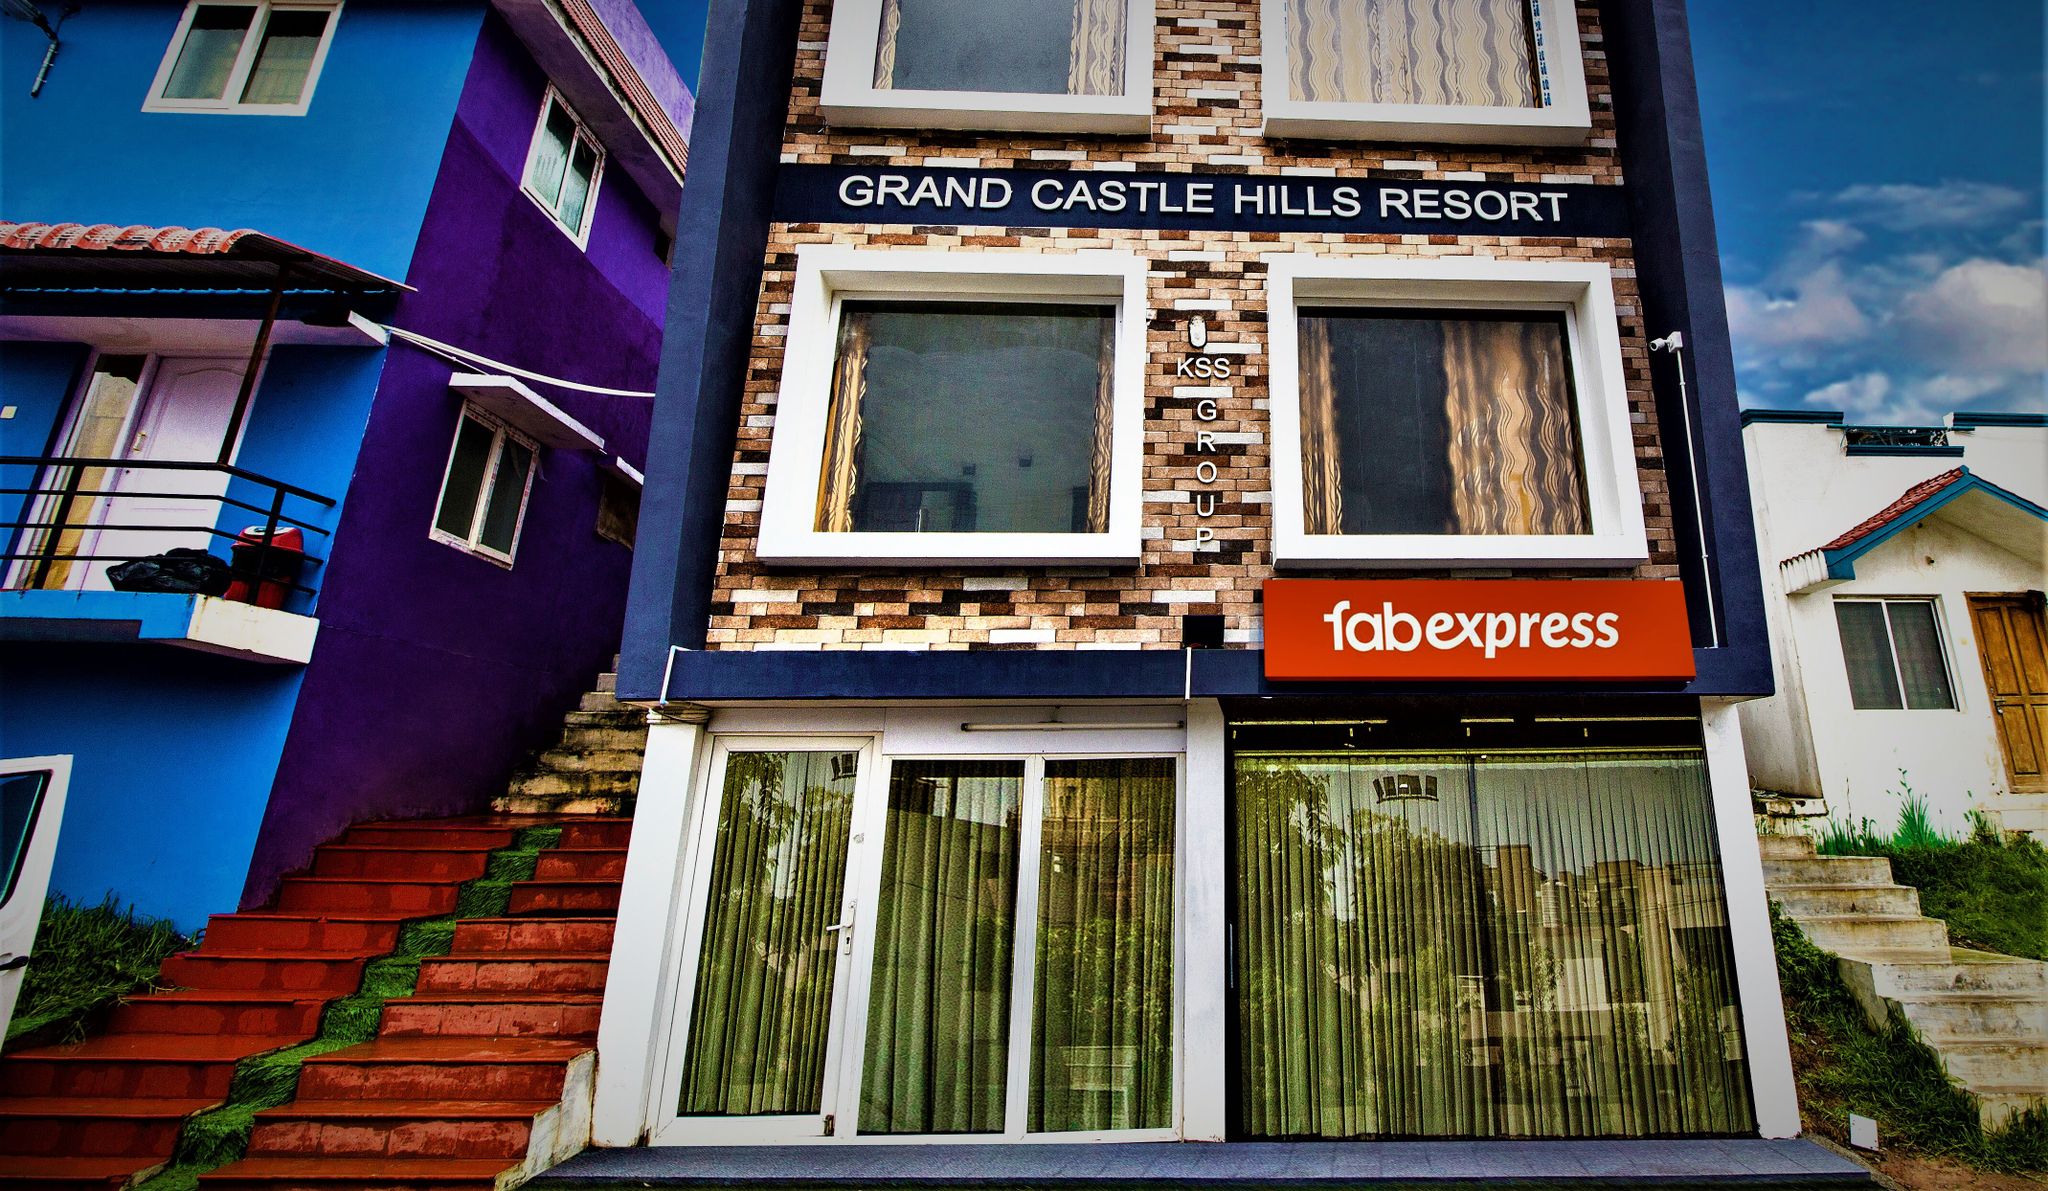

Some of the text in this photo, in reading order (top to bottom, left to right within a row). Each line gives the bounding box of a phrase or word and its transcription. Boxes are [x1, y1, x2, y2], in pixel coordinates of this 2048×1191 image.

[839, 174, 1568, 222] GRAND CASTLE HILLS RESORT
[1177, 357, 1231, 378] KSS
[1196, 399, 1217, 550] GROUP
[1323, 600, 1619, 658] fabexpress
